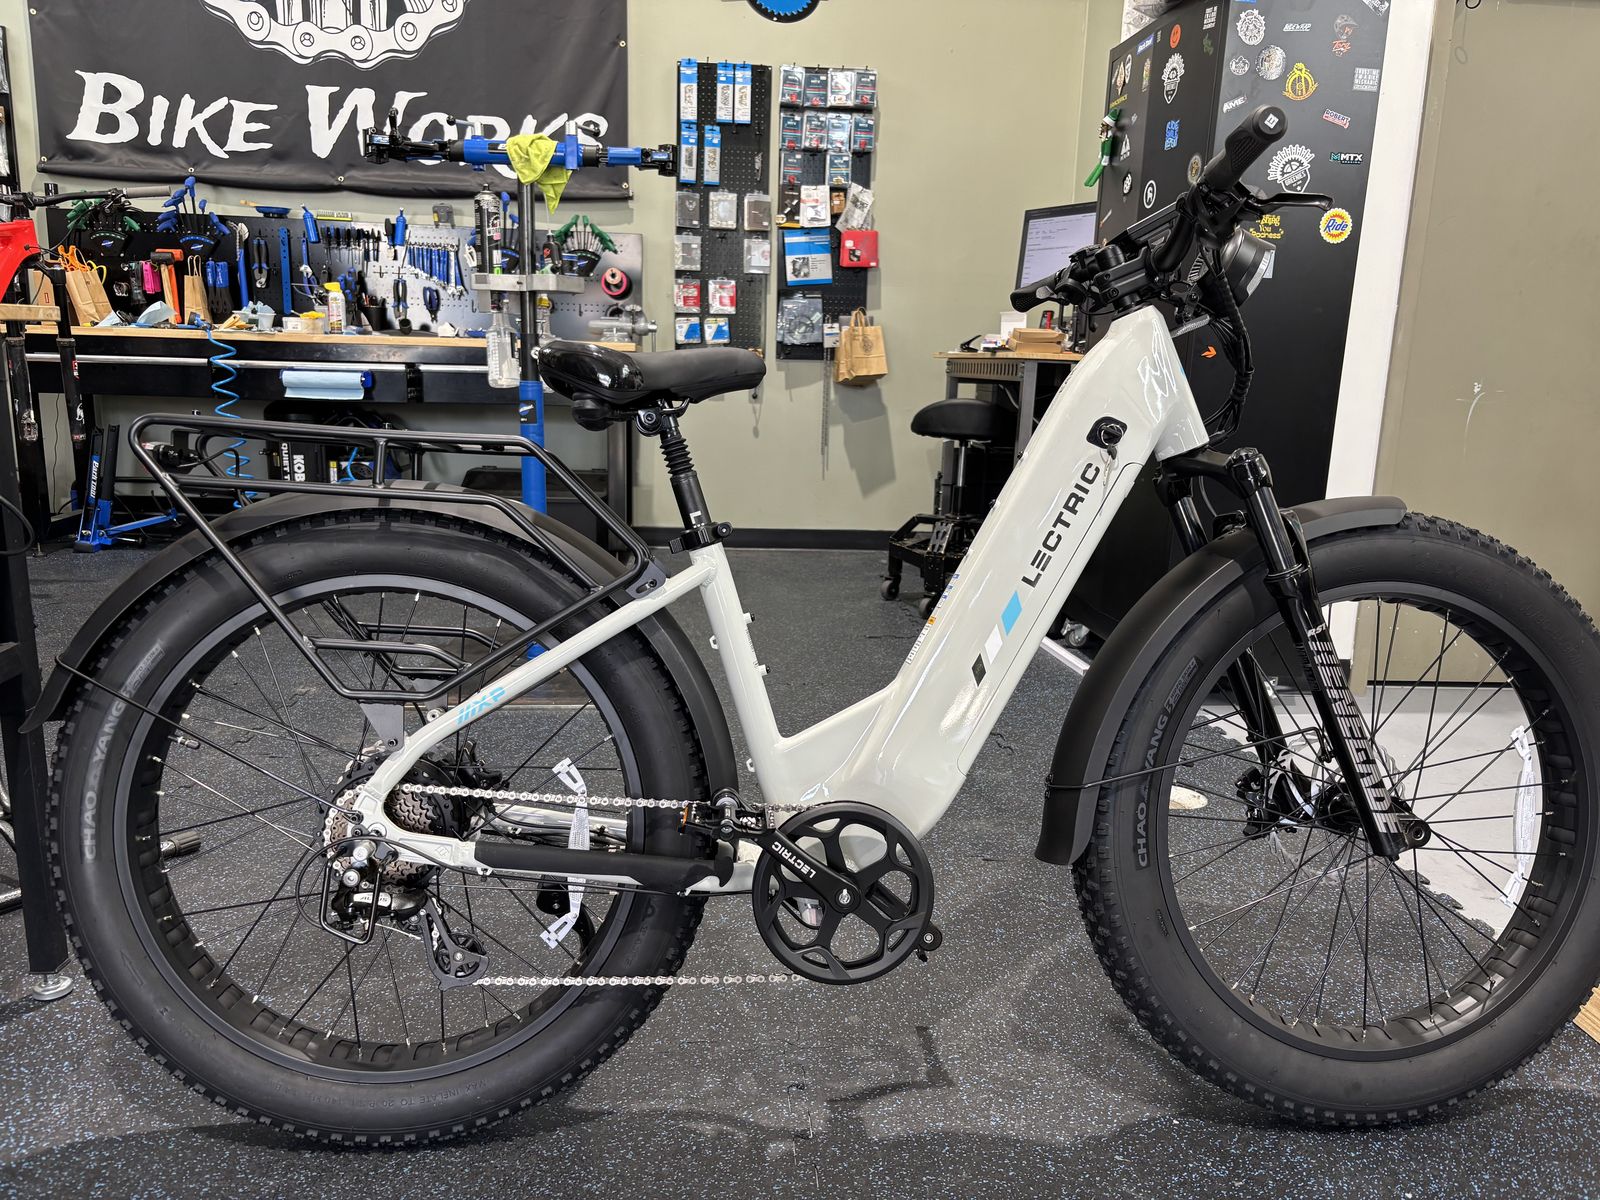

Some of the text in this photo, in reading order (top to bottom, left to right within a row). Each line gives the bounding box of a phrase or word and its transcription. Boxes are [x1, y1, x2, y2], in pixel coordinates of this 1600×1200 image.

[66, 69, 278, 158] BIKE
[1340, 153, 1363, 161] MTX
[1323, 218, 1349, 233] Ride
[281, 442, 289, 472] QUIET
[1021, 462, 1101, 588] LECTRIC
[1308, 641, 1400, 834] RENEGADE
[84, 700, 126, 864] CHAO YANG
[771, 841, 817, 879] LECTRIC
[1135, 805, 1149, 867] CHAO
